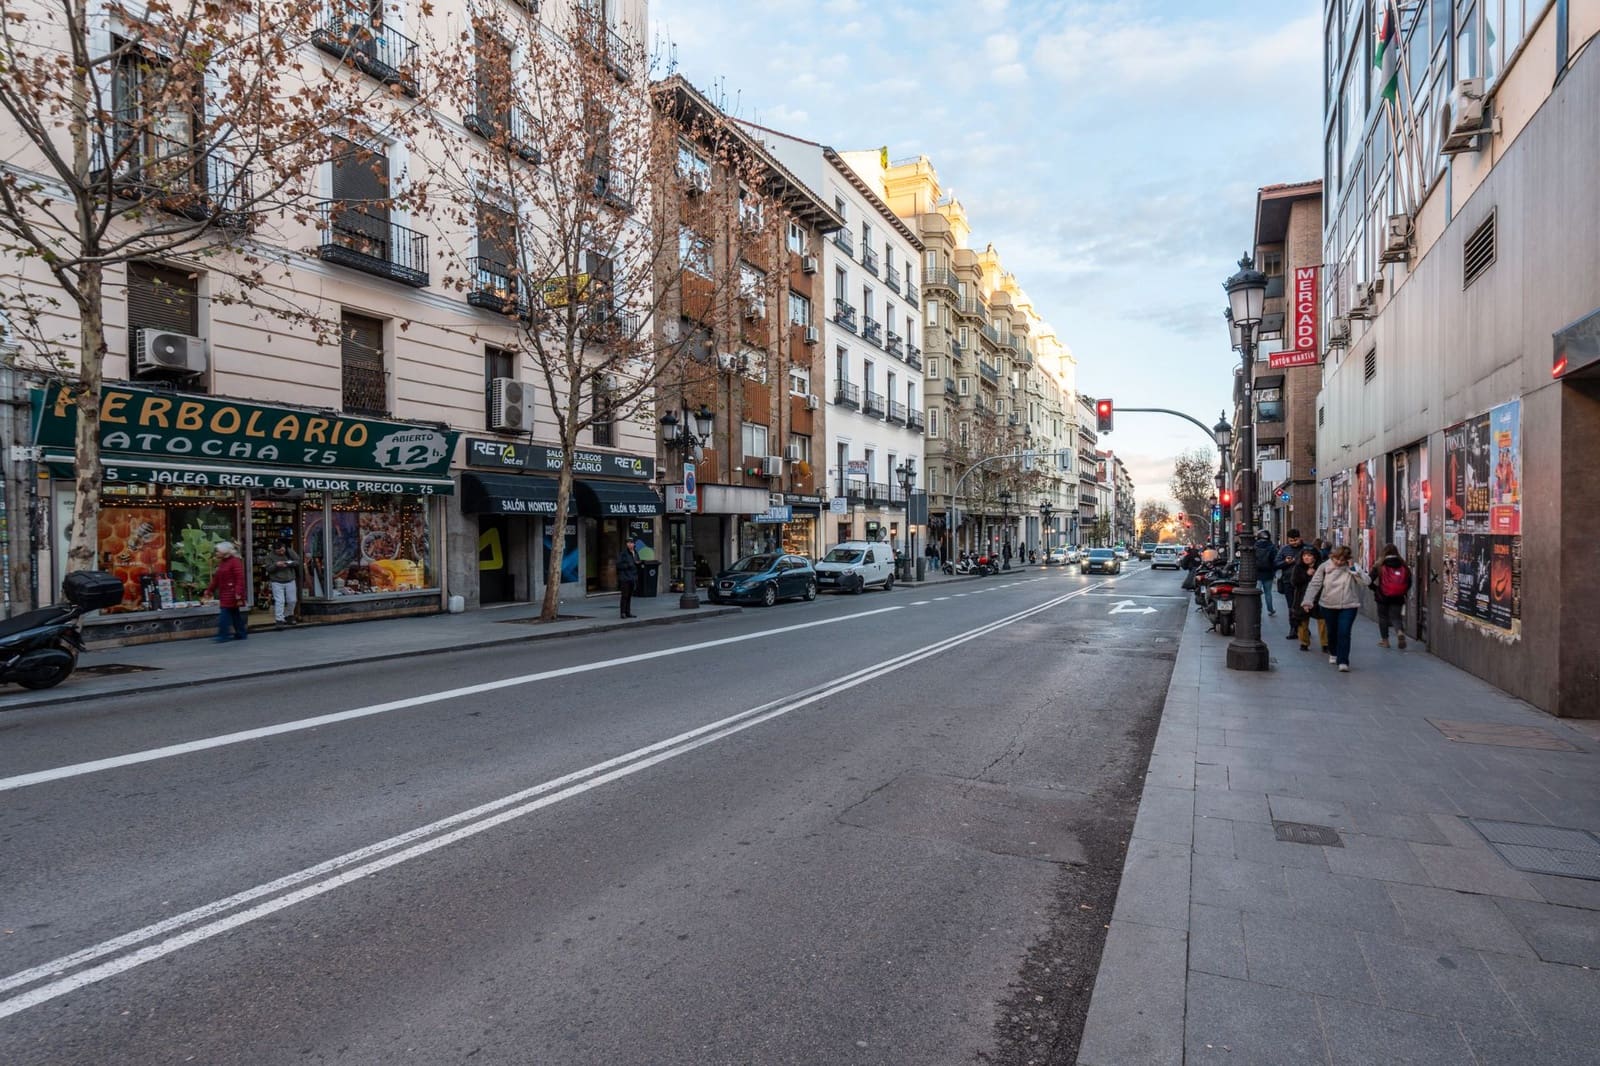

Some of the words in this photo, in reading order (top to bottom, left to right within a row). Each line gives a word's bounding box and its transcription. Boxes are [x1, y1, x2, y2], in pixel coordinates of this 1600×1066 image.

[1297, 268, 1314, 348] MERCADO
[391, 433, 434, 444] ABIERTO
[102, 431, 280, 461] ATOCHA
[303, 448, 338, 464] 75
[384, 444, 429, 466] 12
[503, 457, 524, 467] bet.es
[546, 449, 564, 458] SALÓ
[579, 453, 602, 462] JUEGOS
[149, 470, 209, 485] JALEA
[218, 473, 264, 488] REAL
[273, 478, 295, 489] AL
[302, 478, 350, 491] MEJOR
[357, 481, 404, 494] PRECIO
[419, 484, 434, 495] 75
[502, 497, 526, 512] SALÓN
[610, 503, 628, 513] SALÓN
[628, 504, 637, 513] DE
[638, 504, 657, 514] JUEGOS
